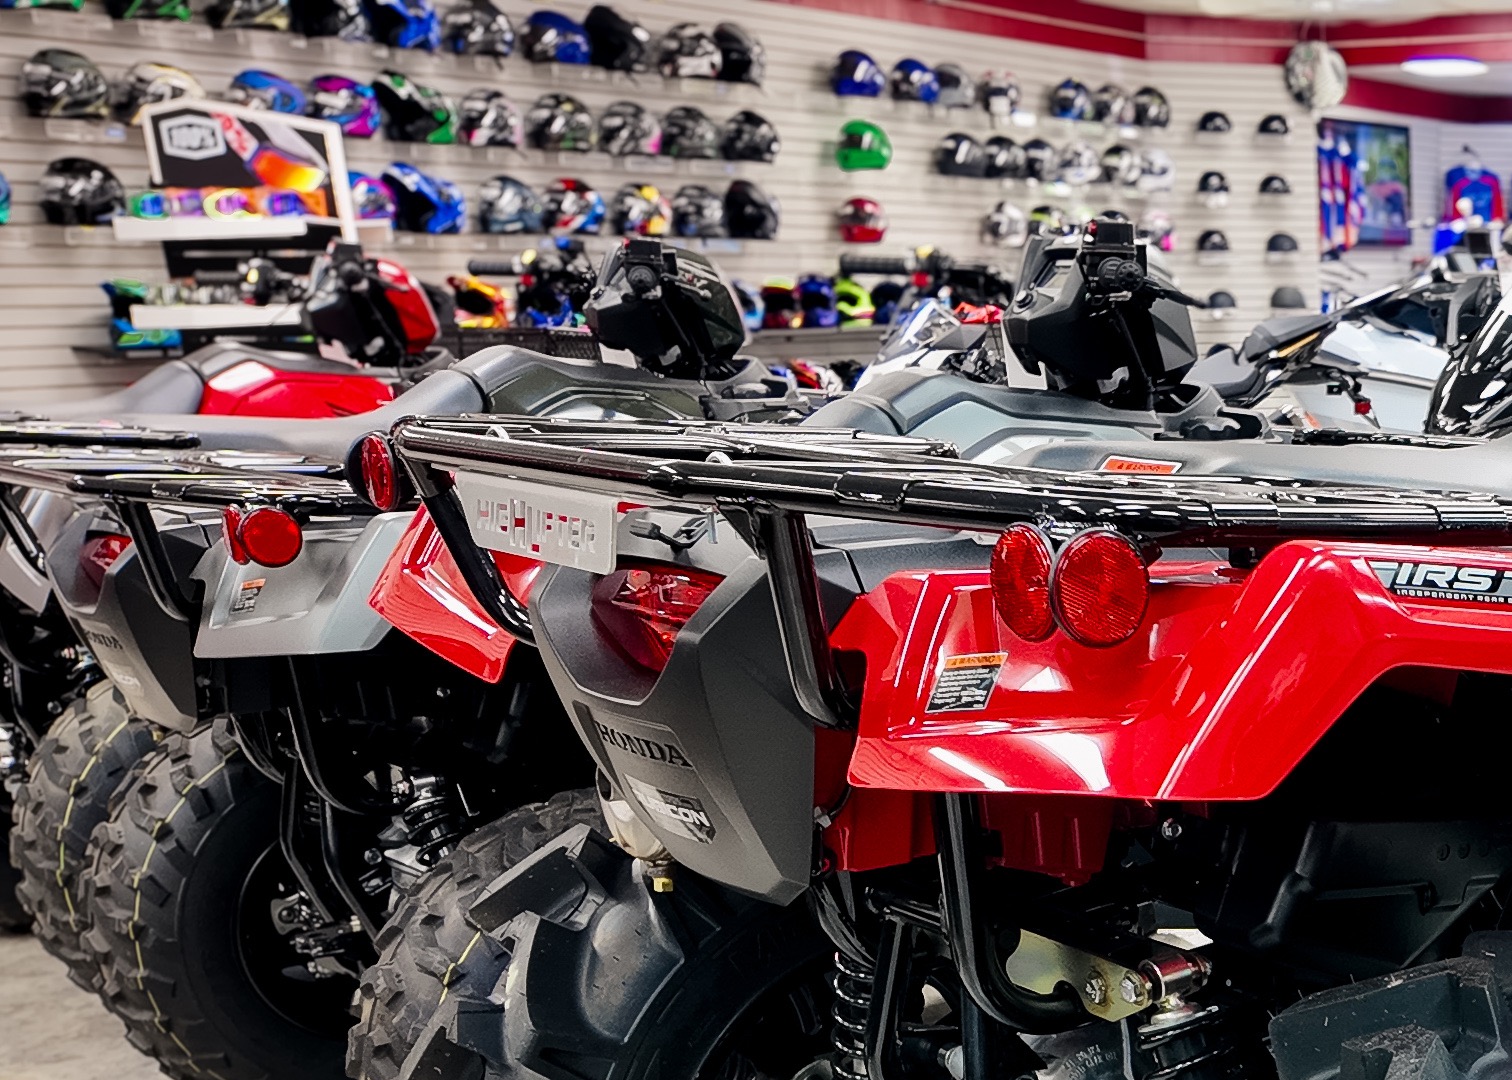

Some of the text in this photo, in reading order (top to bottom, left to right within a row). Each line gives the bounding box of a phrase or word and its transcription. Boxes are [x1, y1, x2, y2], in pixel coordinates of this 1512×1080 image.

[1395, 562, 1497, 592] IRS
[1396, 588, 1475, 601] INDEPENDENT
[1477, 594, 1505, 603] REAR
[594, 720, 693, 768] HONDA
